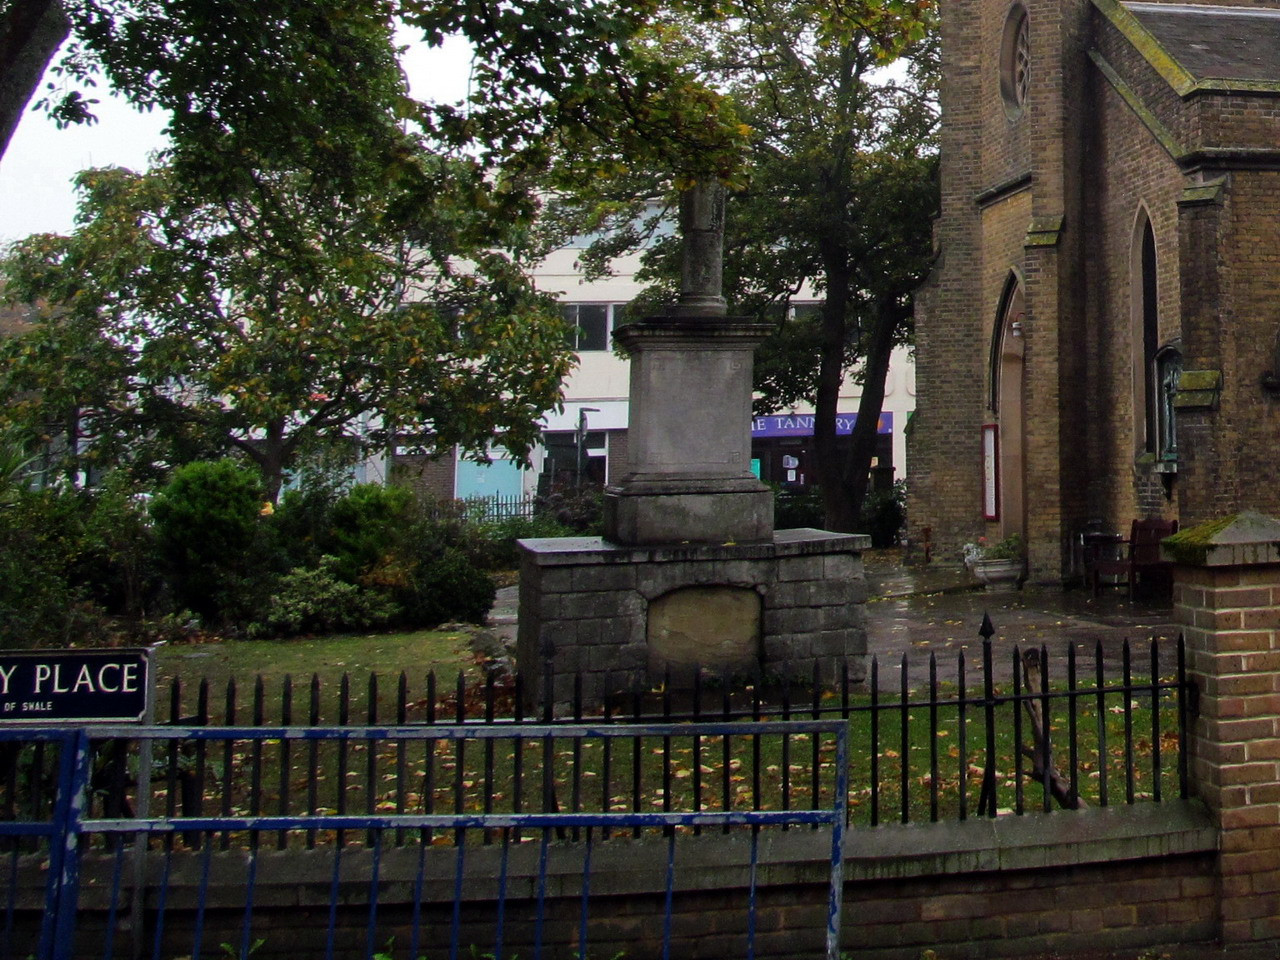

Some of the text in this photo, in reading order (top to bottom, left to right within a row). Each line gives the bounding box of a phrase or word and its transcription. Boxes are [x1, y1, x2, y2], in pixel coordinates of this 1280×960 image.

[33, 663, 138, 693] PLACE
[4, 701, 53, 712] OF SWALE
